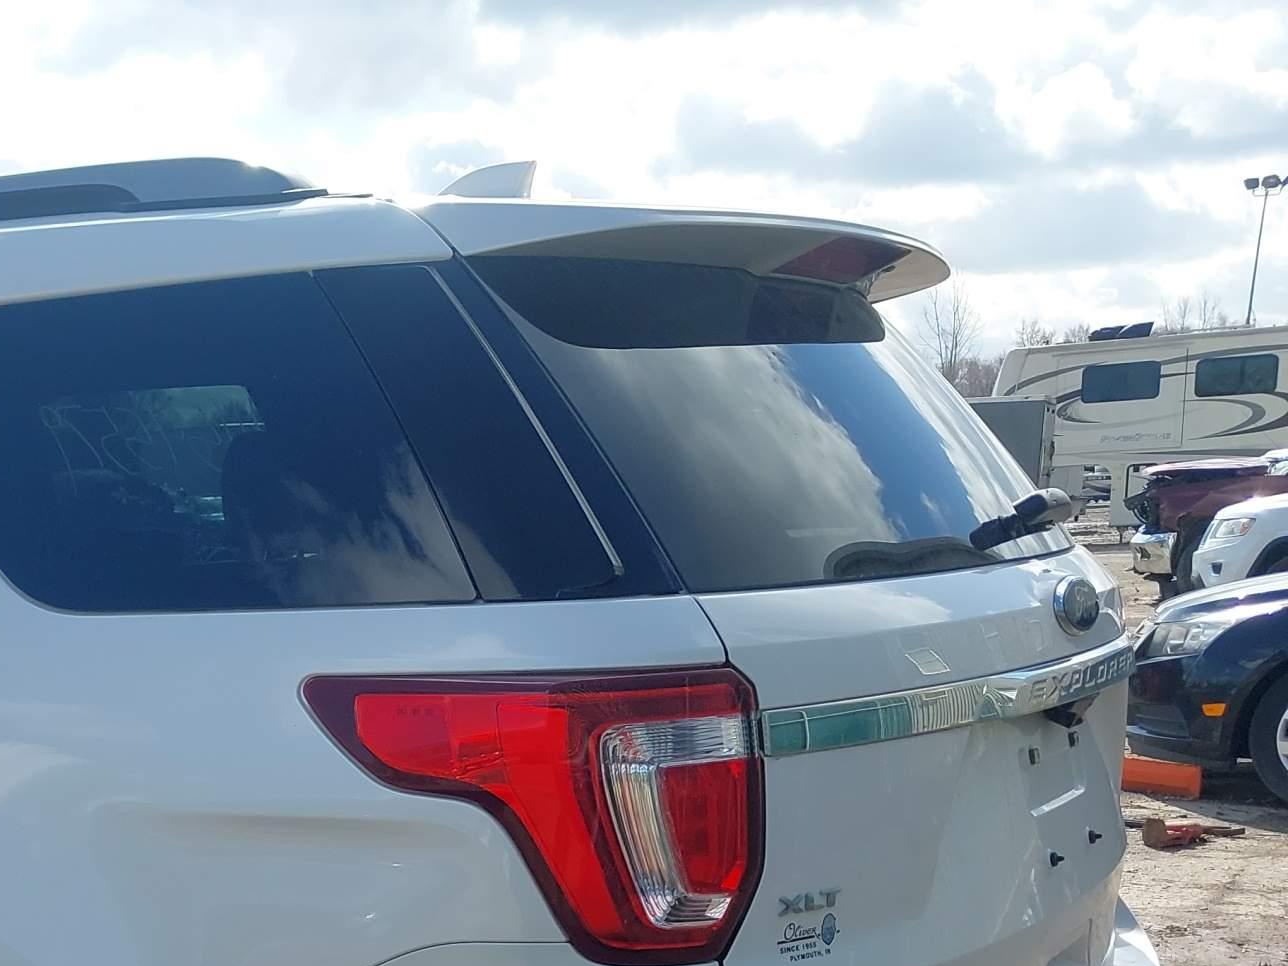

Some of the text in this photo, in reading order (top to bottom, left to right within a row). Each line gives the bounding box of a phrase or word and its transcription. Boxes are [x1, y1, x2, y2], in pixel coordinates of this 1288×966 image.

[1029, 651, 1133, 704] EXPLORER
[777, 887, 843, 917] XLT
[779, 944, 800, 954] SINCE
